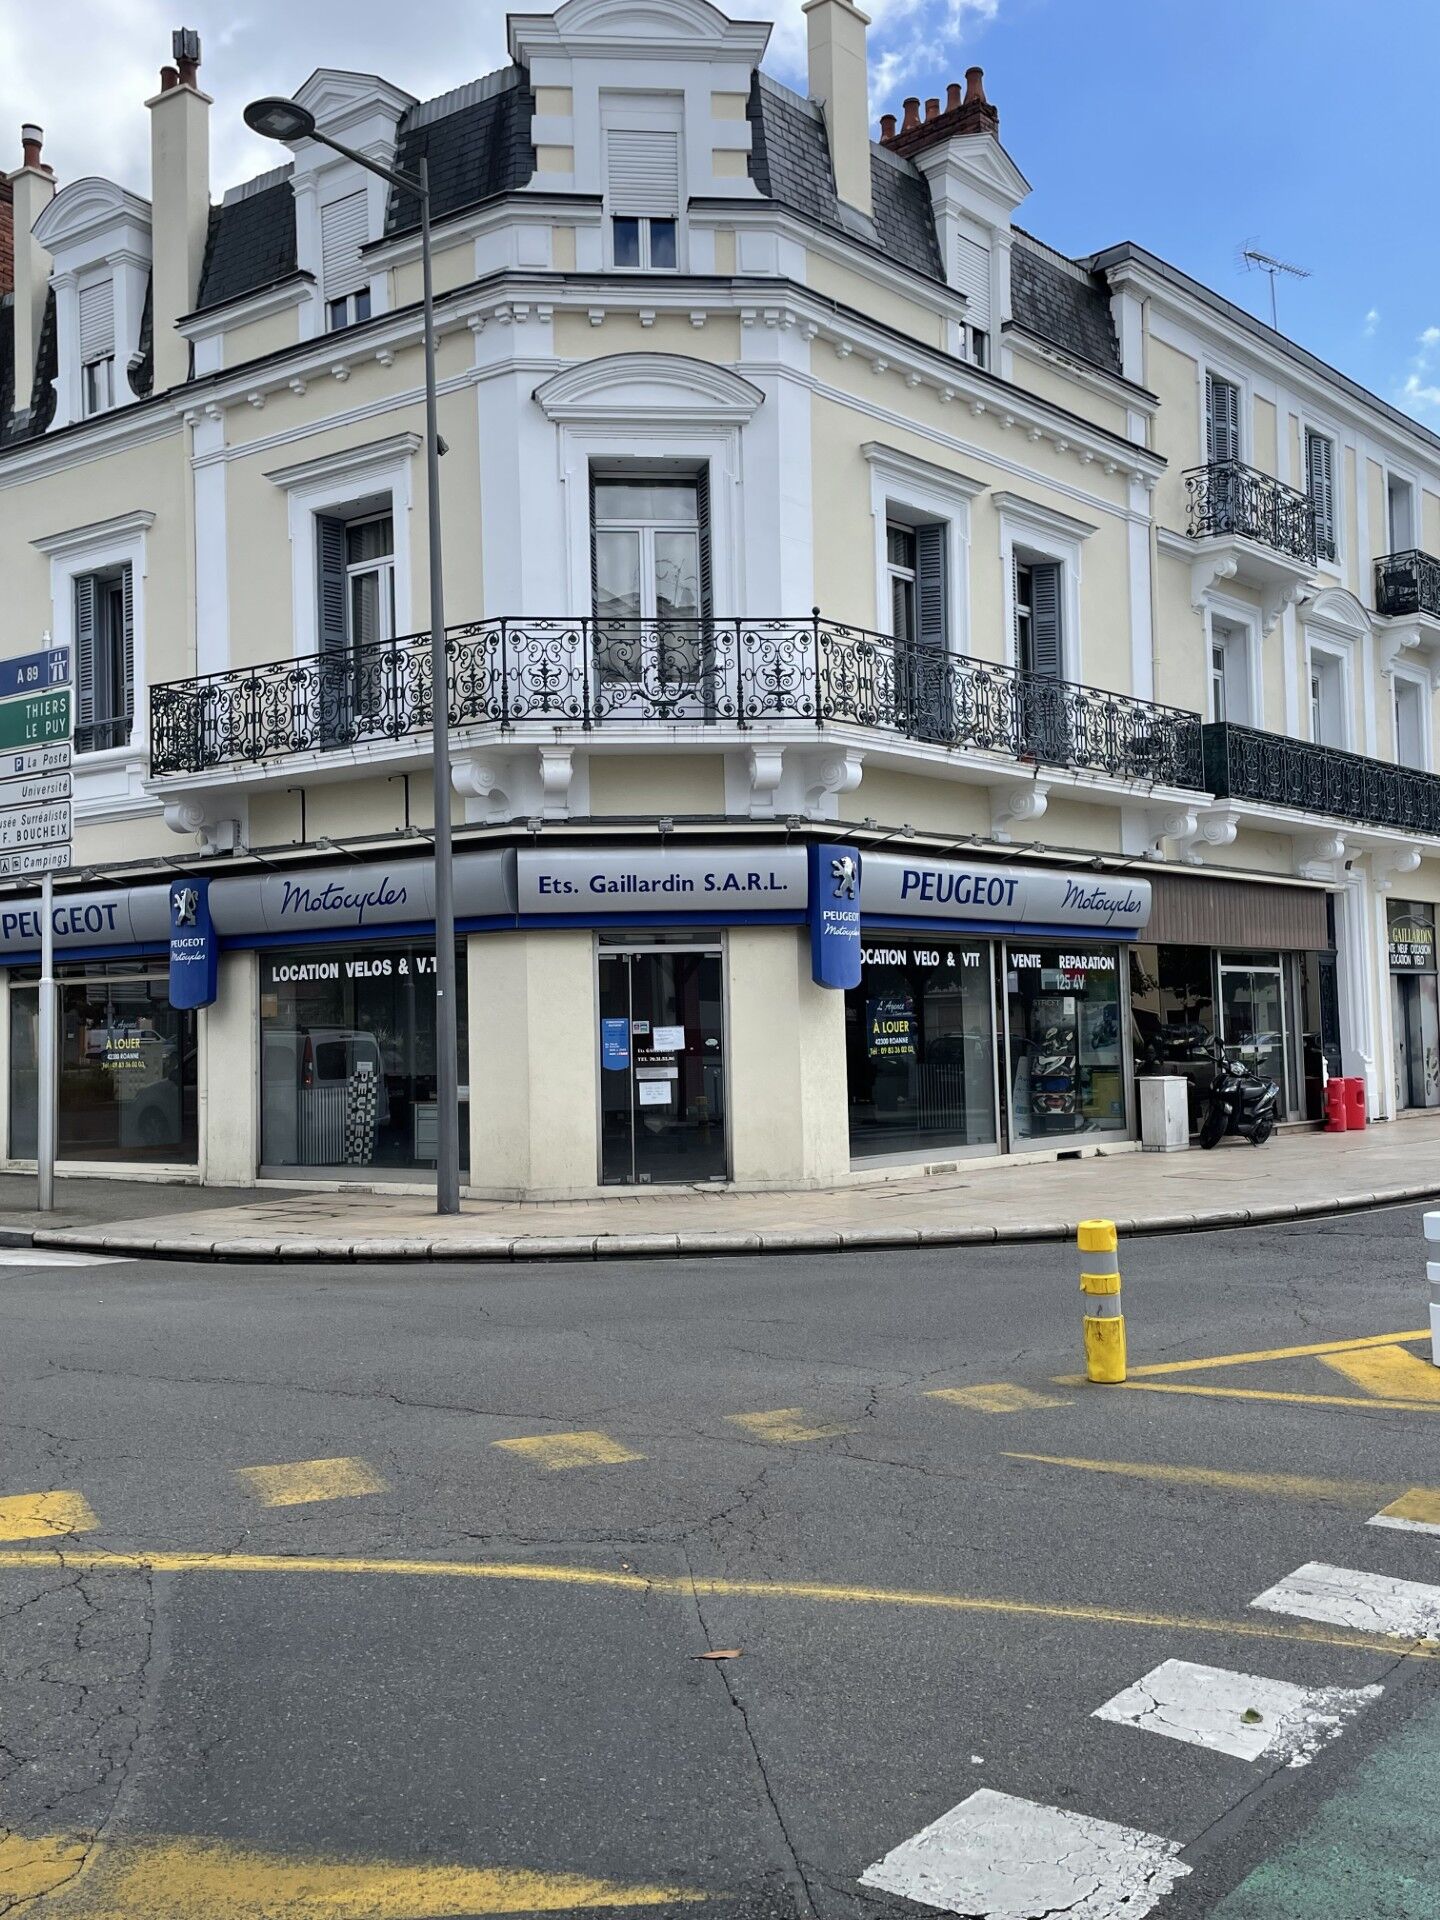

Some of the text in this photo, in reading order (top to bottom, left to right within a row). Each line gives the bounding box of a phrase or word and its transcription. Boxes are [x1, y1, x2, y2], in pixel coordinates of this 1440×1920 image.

[17, 665, 39, 684] A 89
[26, 698, 66, 719] THIERS
[26, 717, 66, 739] LE PUY
[27, 757, 37, 768] La
[43, 753, 67, 766] Poste
[22, 780, 68, 798] Université
[0, 810, 67, 829] usée Surréaliste
[16, 823, 67, 841] BOUCHEIX
[24, 854, 68, 868] Campings
[538, 872, 788, 894] Ets. Gaillardin S.A.R.L.
[900, 870, 1019, 907] PEUGEOT
[280, 876, 407, 924] Motocycles
[1060, 879, 1142, 928] Motocycles
[823, 910, 860, 921] PEUGEOT
[170, 937, 206, 948] PEUGEOT
[171, 950, 206, 965] Motocycles
[860, 948, 980, 967] OCATION VELO & VTT
[1011, 953, 1115, 970] VENTE REPARATION
[272, 962, 339, 982] LOCATION
[345, 959, 392, 978] VELOS
[398, 957, 409, 975] &
[1055, 974, 1085, 990] 125 4V
[873, 1018, 909, 1034] À LOUER
[105, 1035, 141, 1050] À LOUER
[353, 1070, 369, 1164] PEUGEOT
